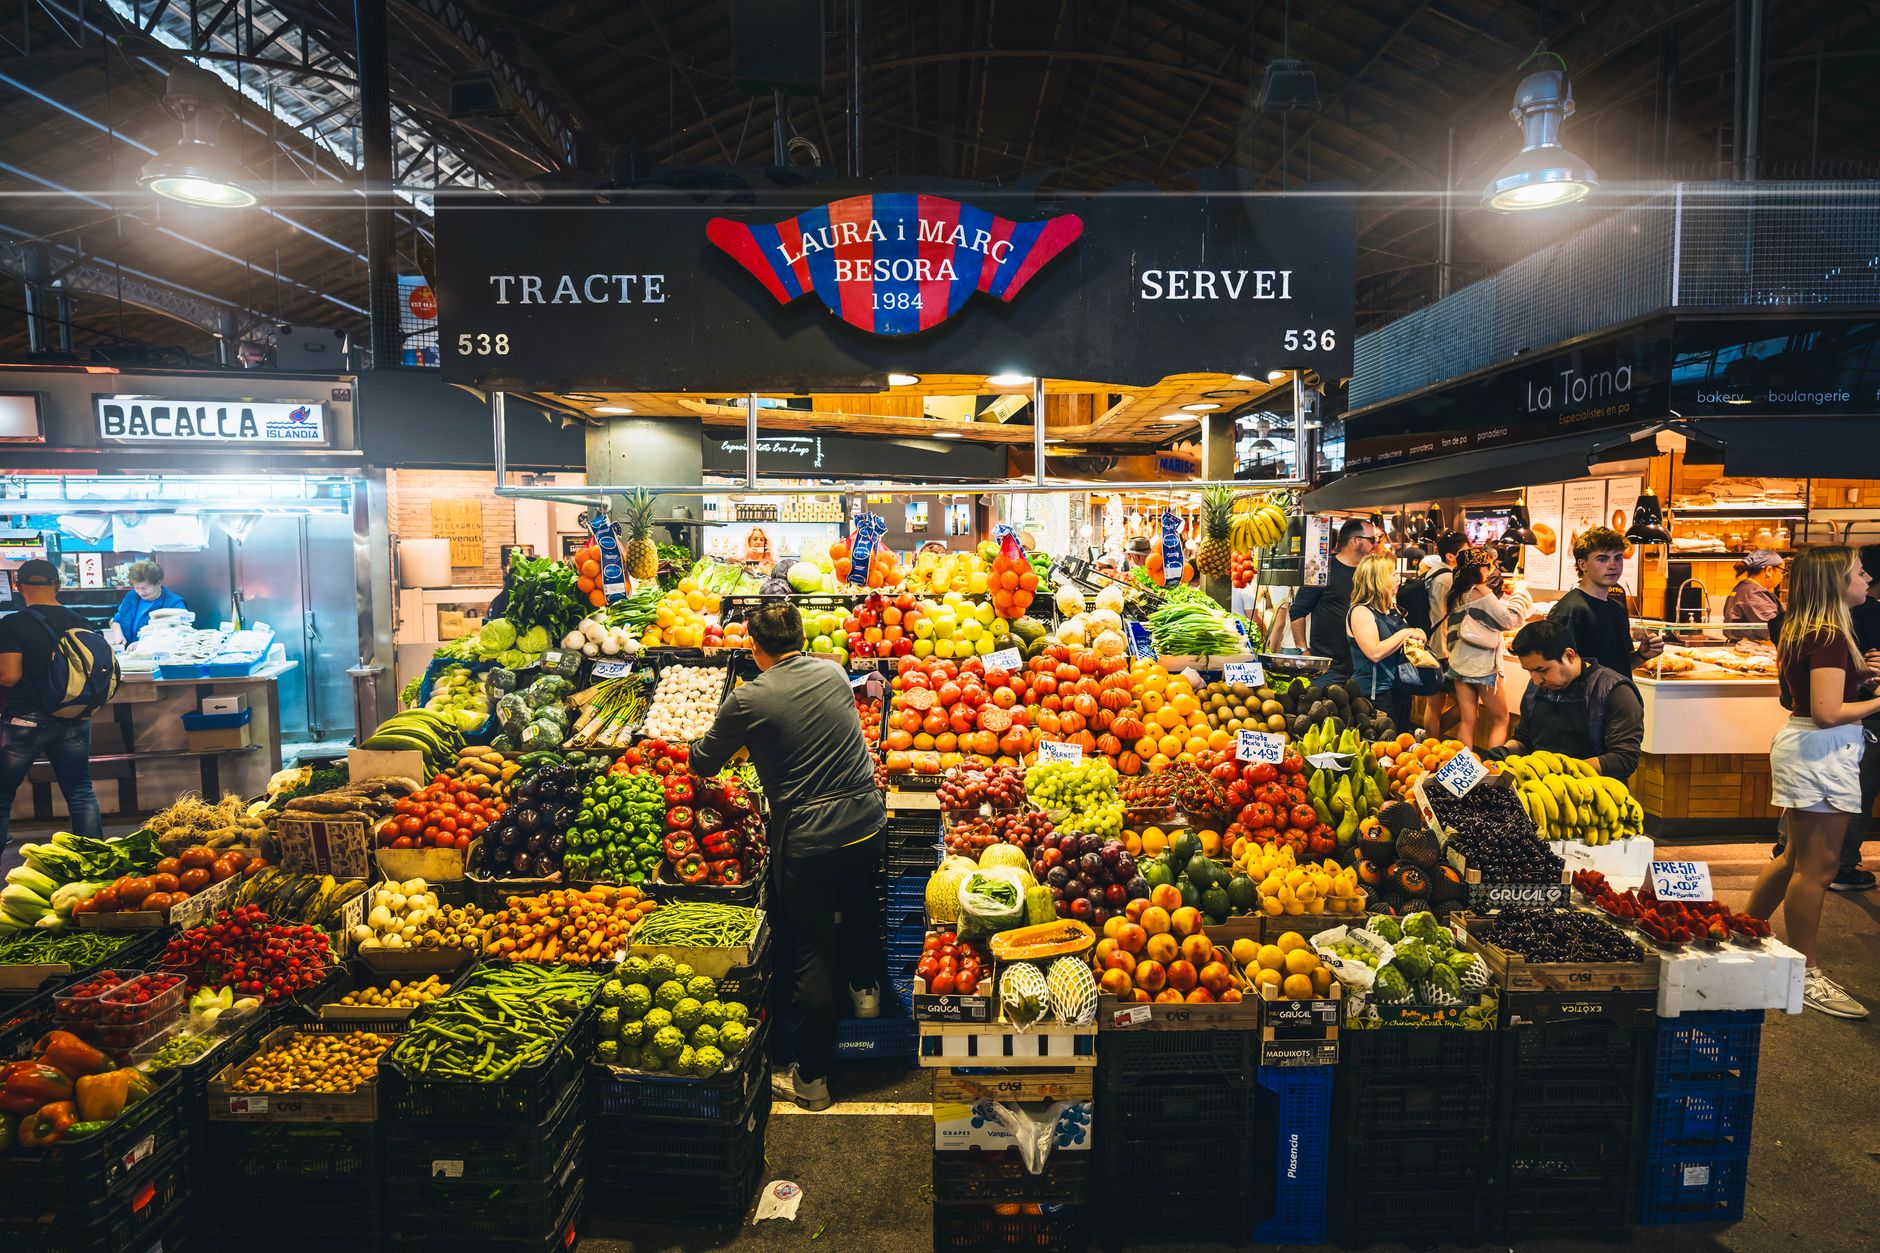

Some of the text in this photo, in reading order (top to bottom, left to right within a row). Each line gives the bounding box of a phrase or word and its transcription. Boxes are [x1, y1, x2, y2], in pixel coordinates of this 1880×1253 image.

[776, 218, 1015, 266] LAURA i MARC
[833, 258, 960, 282] BESORA
[489, 274, 666, 305] TRACTE
[1140, 269, 1293, 301] SERVEI
[872, 292, 924, 310] 1984
[457, 333, 511, 356] 538
[1283, 329, 1337, 352] 536
[1528, 365, 1632, 412] La Torna
[1697, 389, 1850, 405] bakery boulangerie
[1559, 403, 1630, 426] Especialistes en pa
[266, 429, 319, 439] ISLANDIA
[1240, 730, 1268, 742] Tomate
[1436, 753, 1466, 782] CEREZA
[1652, 862, 1697, 875] FRESA
[1489, 888, 1546, 901] GRUCAL
[1568, 973, 1593, 983] CASI
[927, 1005, 961, 1013] GRUCAL
[1279, 1011, 1312, 1019] GRUCAL
[1561, 1005, 1602, 1014] EXÓTICA
[838, 1041, 875, 1050] Plasencia
[1265, 1050, 1311, 1058] MADUIXOTS
[998, 1082, 1022, 1092] CASI
[1287, 1133, 1299, 1179] Plasencia
